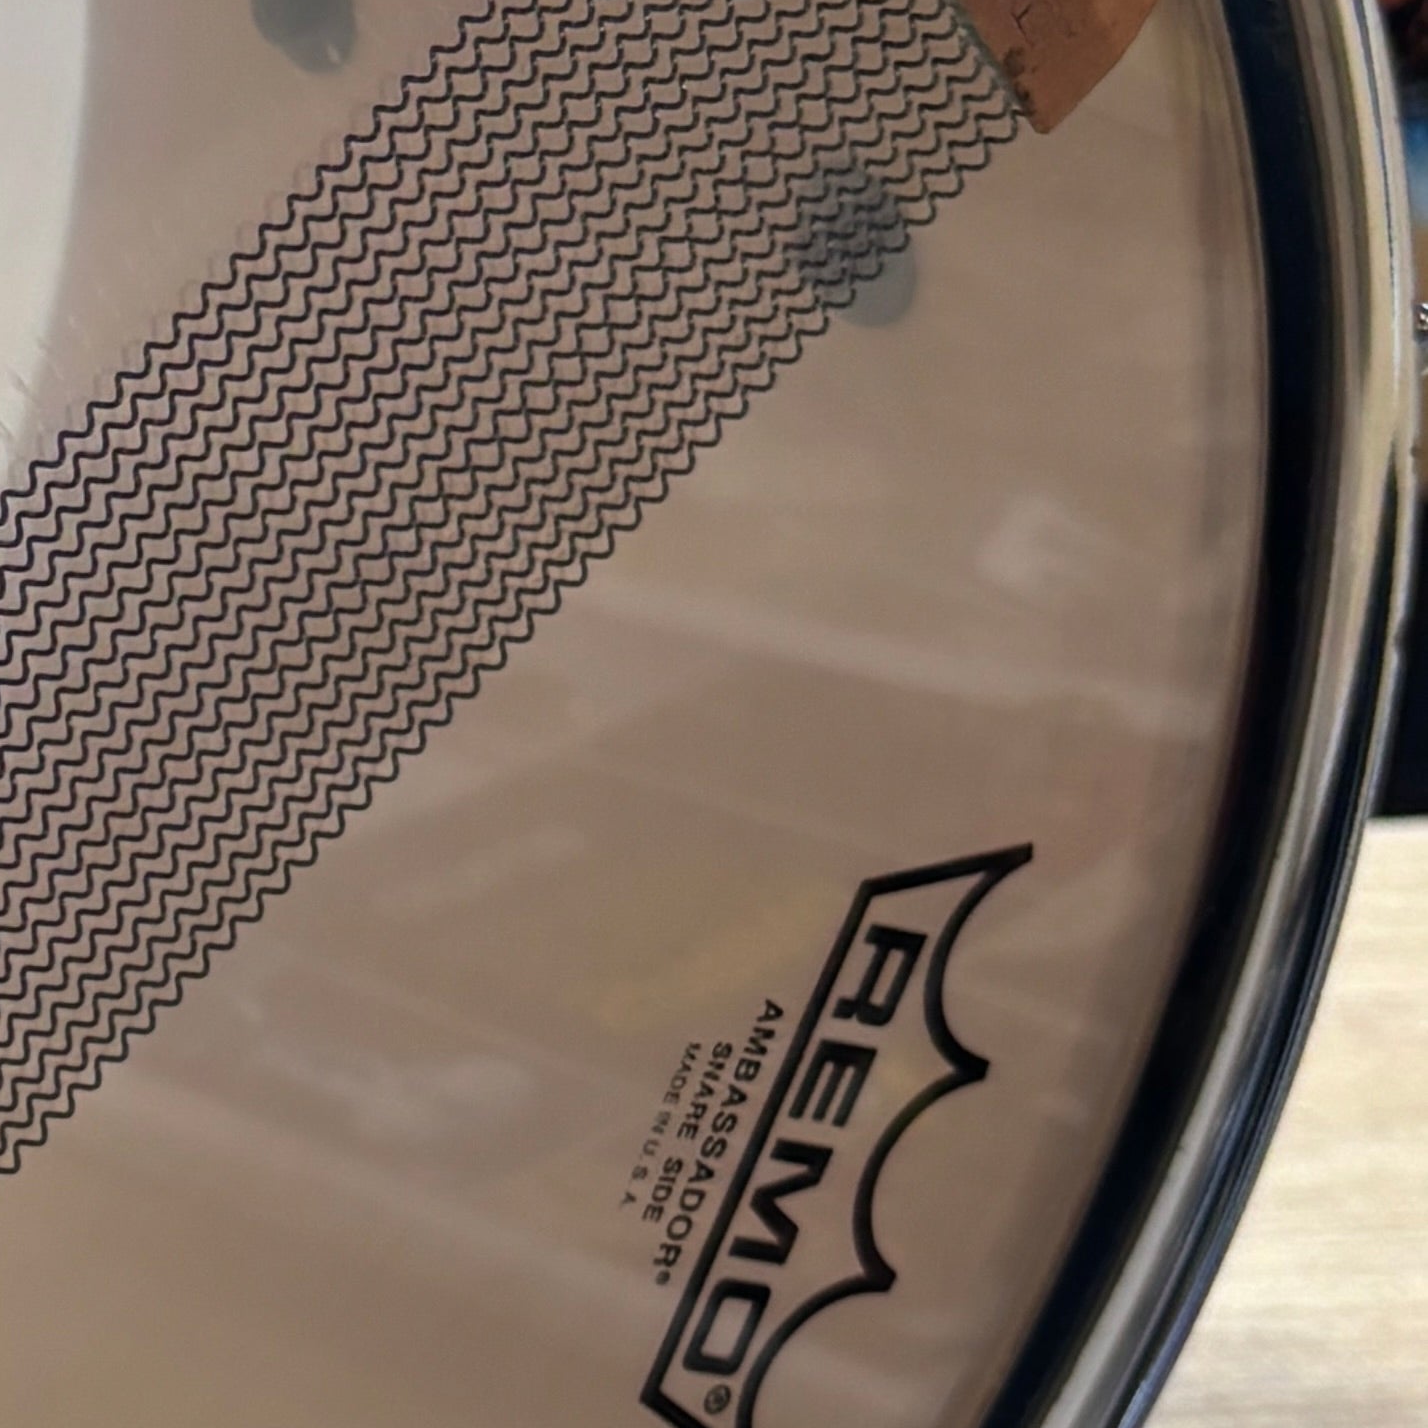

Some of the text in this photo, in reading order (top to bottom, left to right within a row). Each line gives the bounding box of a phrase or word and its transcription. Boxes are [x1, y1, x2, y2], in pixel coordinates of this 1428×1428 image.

[642, 1042, 733, 1223] SNARE SIDE
[664, 1042, 701, 1106] MADE
